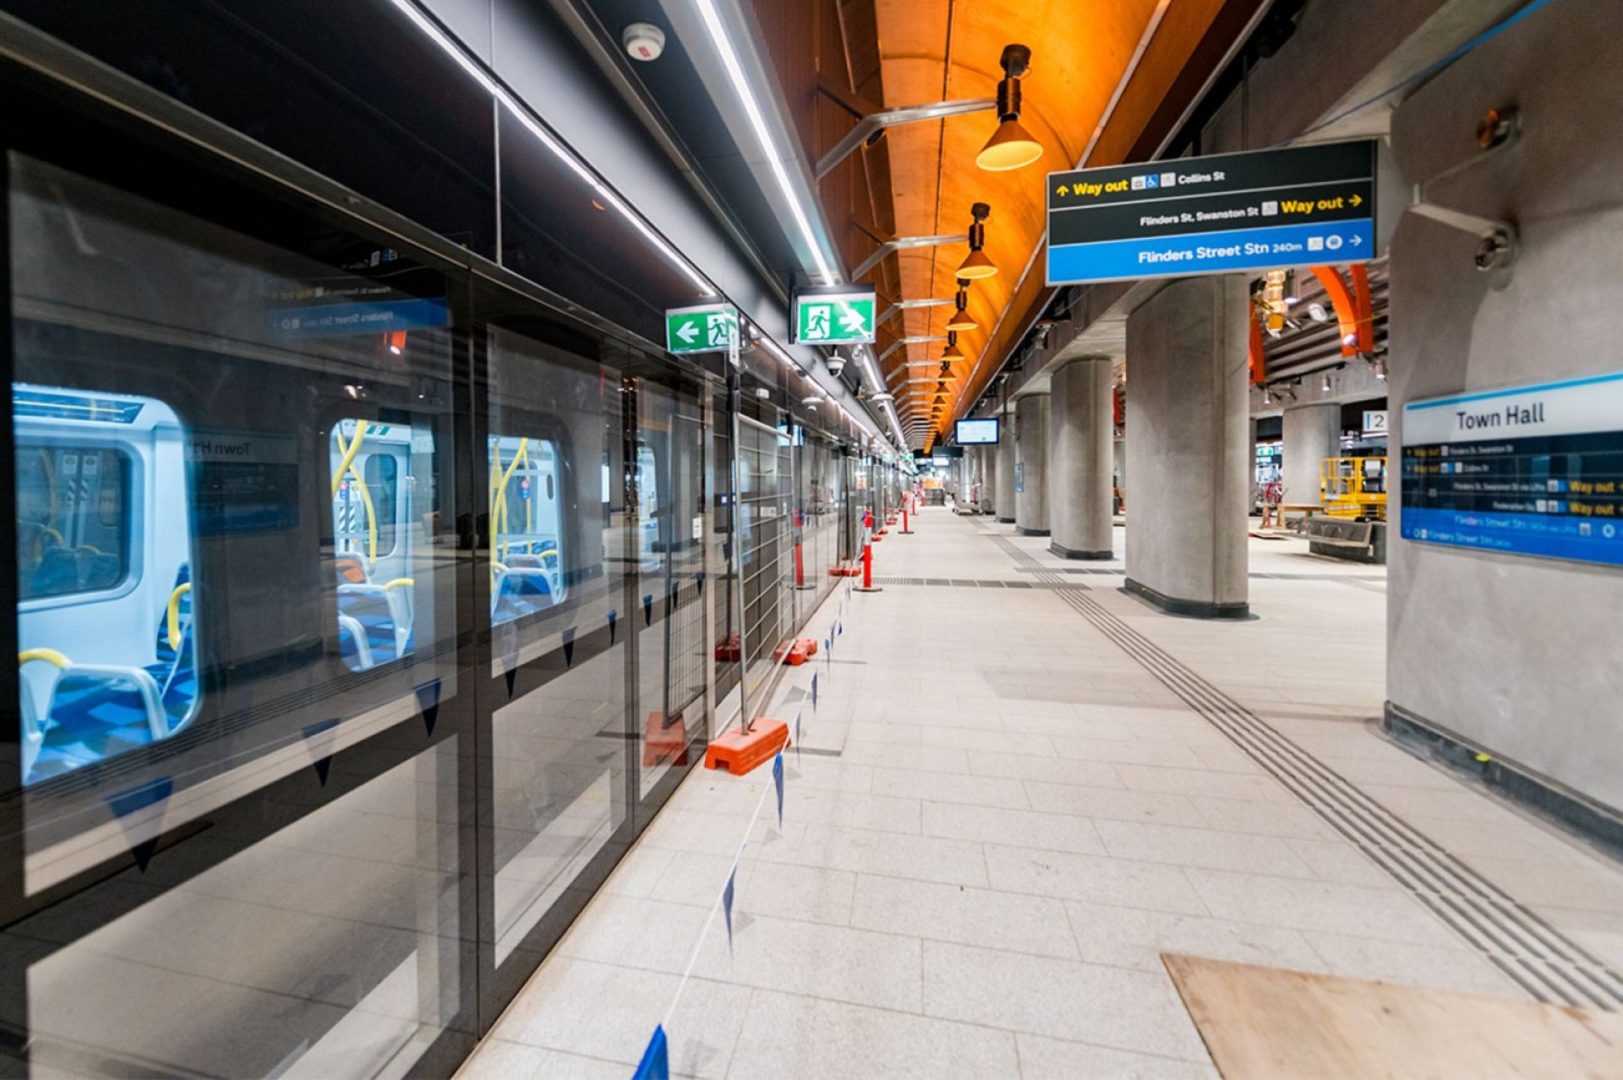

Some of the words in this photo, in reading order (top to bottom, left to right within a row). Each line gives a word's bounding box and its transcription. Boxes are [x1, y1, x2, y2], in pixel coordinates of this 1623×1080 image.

[1073, 182, 1102, 197] Way
[1105, 179, 1129, 193] out
[1178, 172, 1212, 185] Collins
[1213, 171, 1226, 181] St
[1140, 214, 1179, 227] Flinders
[1196, 207, 1246, 222] Swanston
[1247, 206, 1259, 217] St
[1281, 200, 1315, 214] Way
[1317, 196, 1344, 210] out
[1138, 248, 1194, 264] Flinders
[1196, 245, 1241, 260] Street
[1244, 242, 1270, 255] Stn
[1272, 243, 1303, 254] 240m
[1456, 410, 1501, 430] Town
[1506, 402, 1545, 426] Hall
[1569, 480, 1593, 494] Way
[1569, 502, 1593, 516] Way
